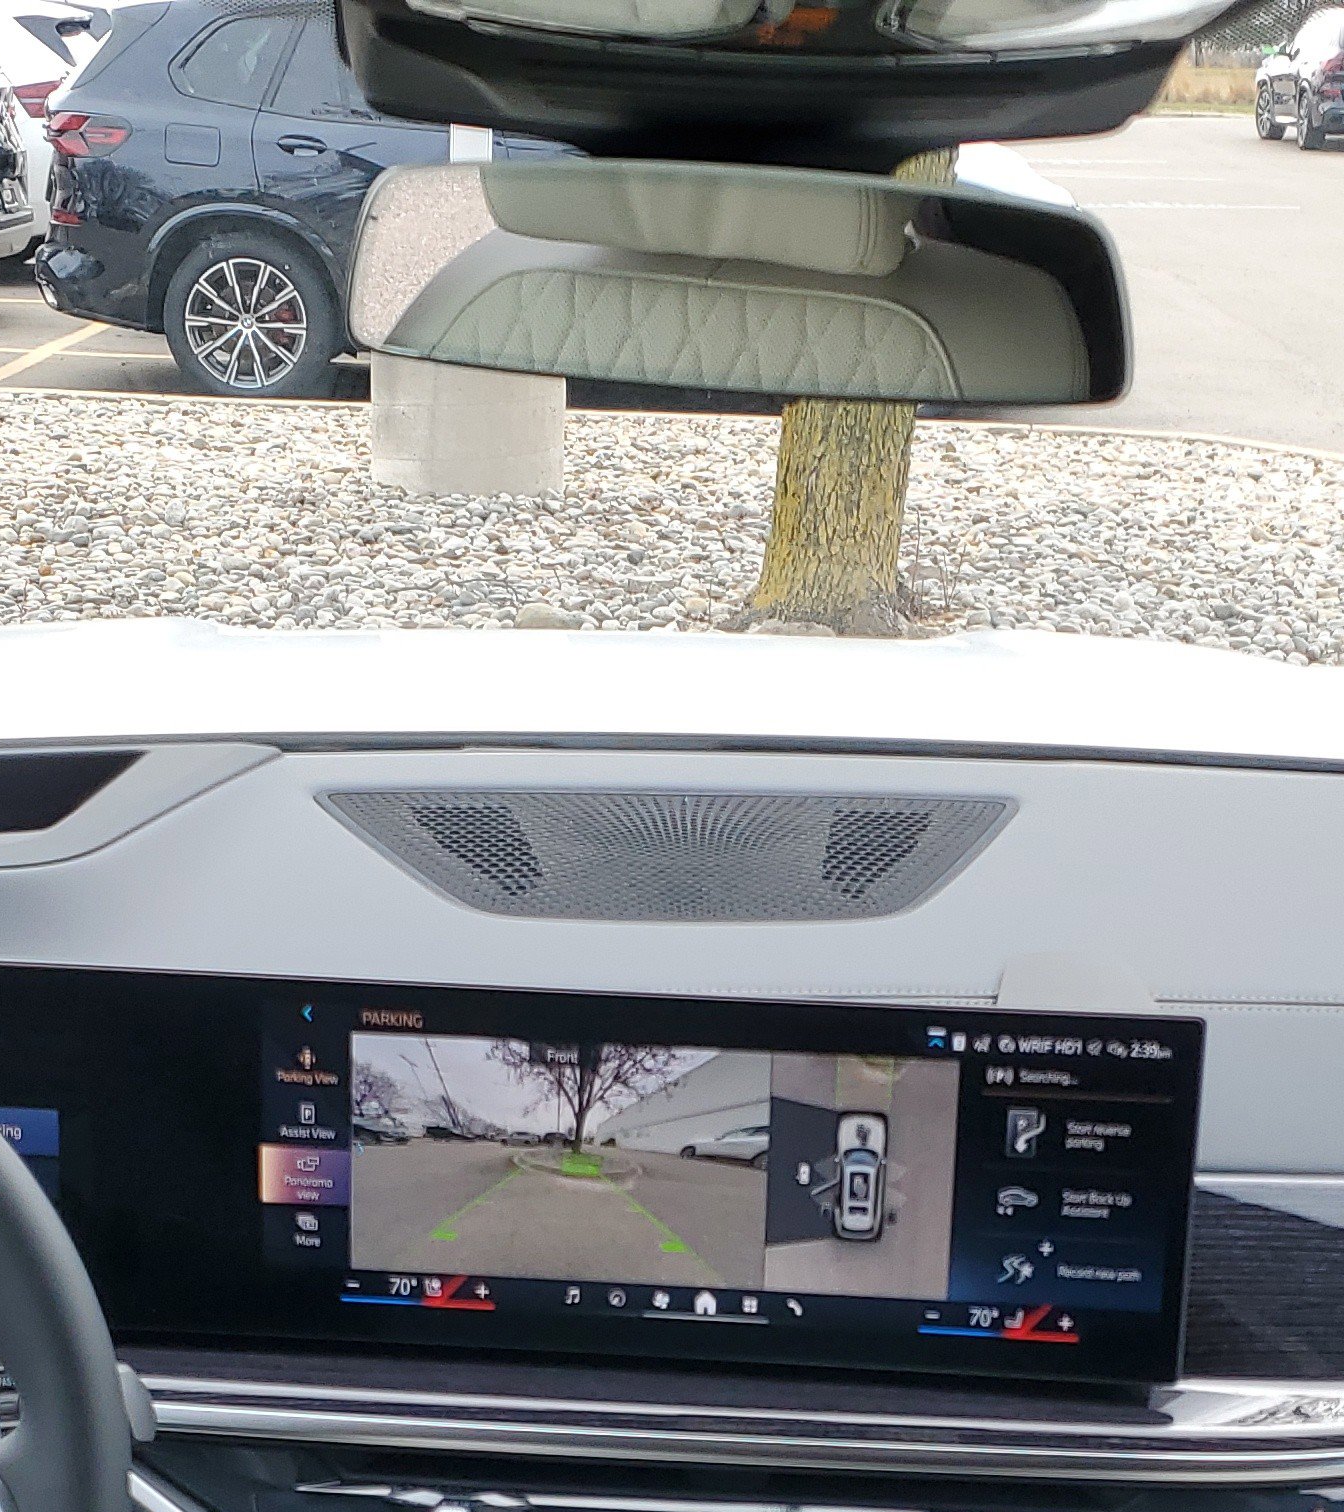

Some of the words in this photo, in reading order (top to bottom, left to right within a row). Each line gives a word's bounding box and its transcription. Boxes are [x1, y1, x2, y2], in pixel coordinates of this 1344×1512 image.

[362, 1012, 423, 1028] PARKING
[1018, 1037, 1052, 1055] WRIF
[277, 1071, 313, 1086] Parking
[314, 1072, 339, 1086] View
[281, 1127, 310, 1139] Assist
[312, 1127, 337, 1140] View
[285, 1175, 334, 1189] Panorama
[295, 1234, 321, 1247] More
